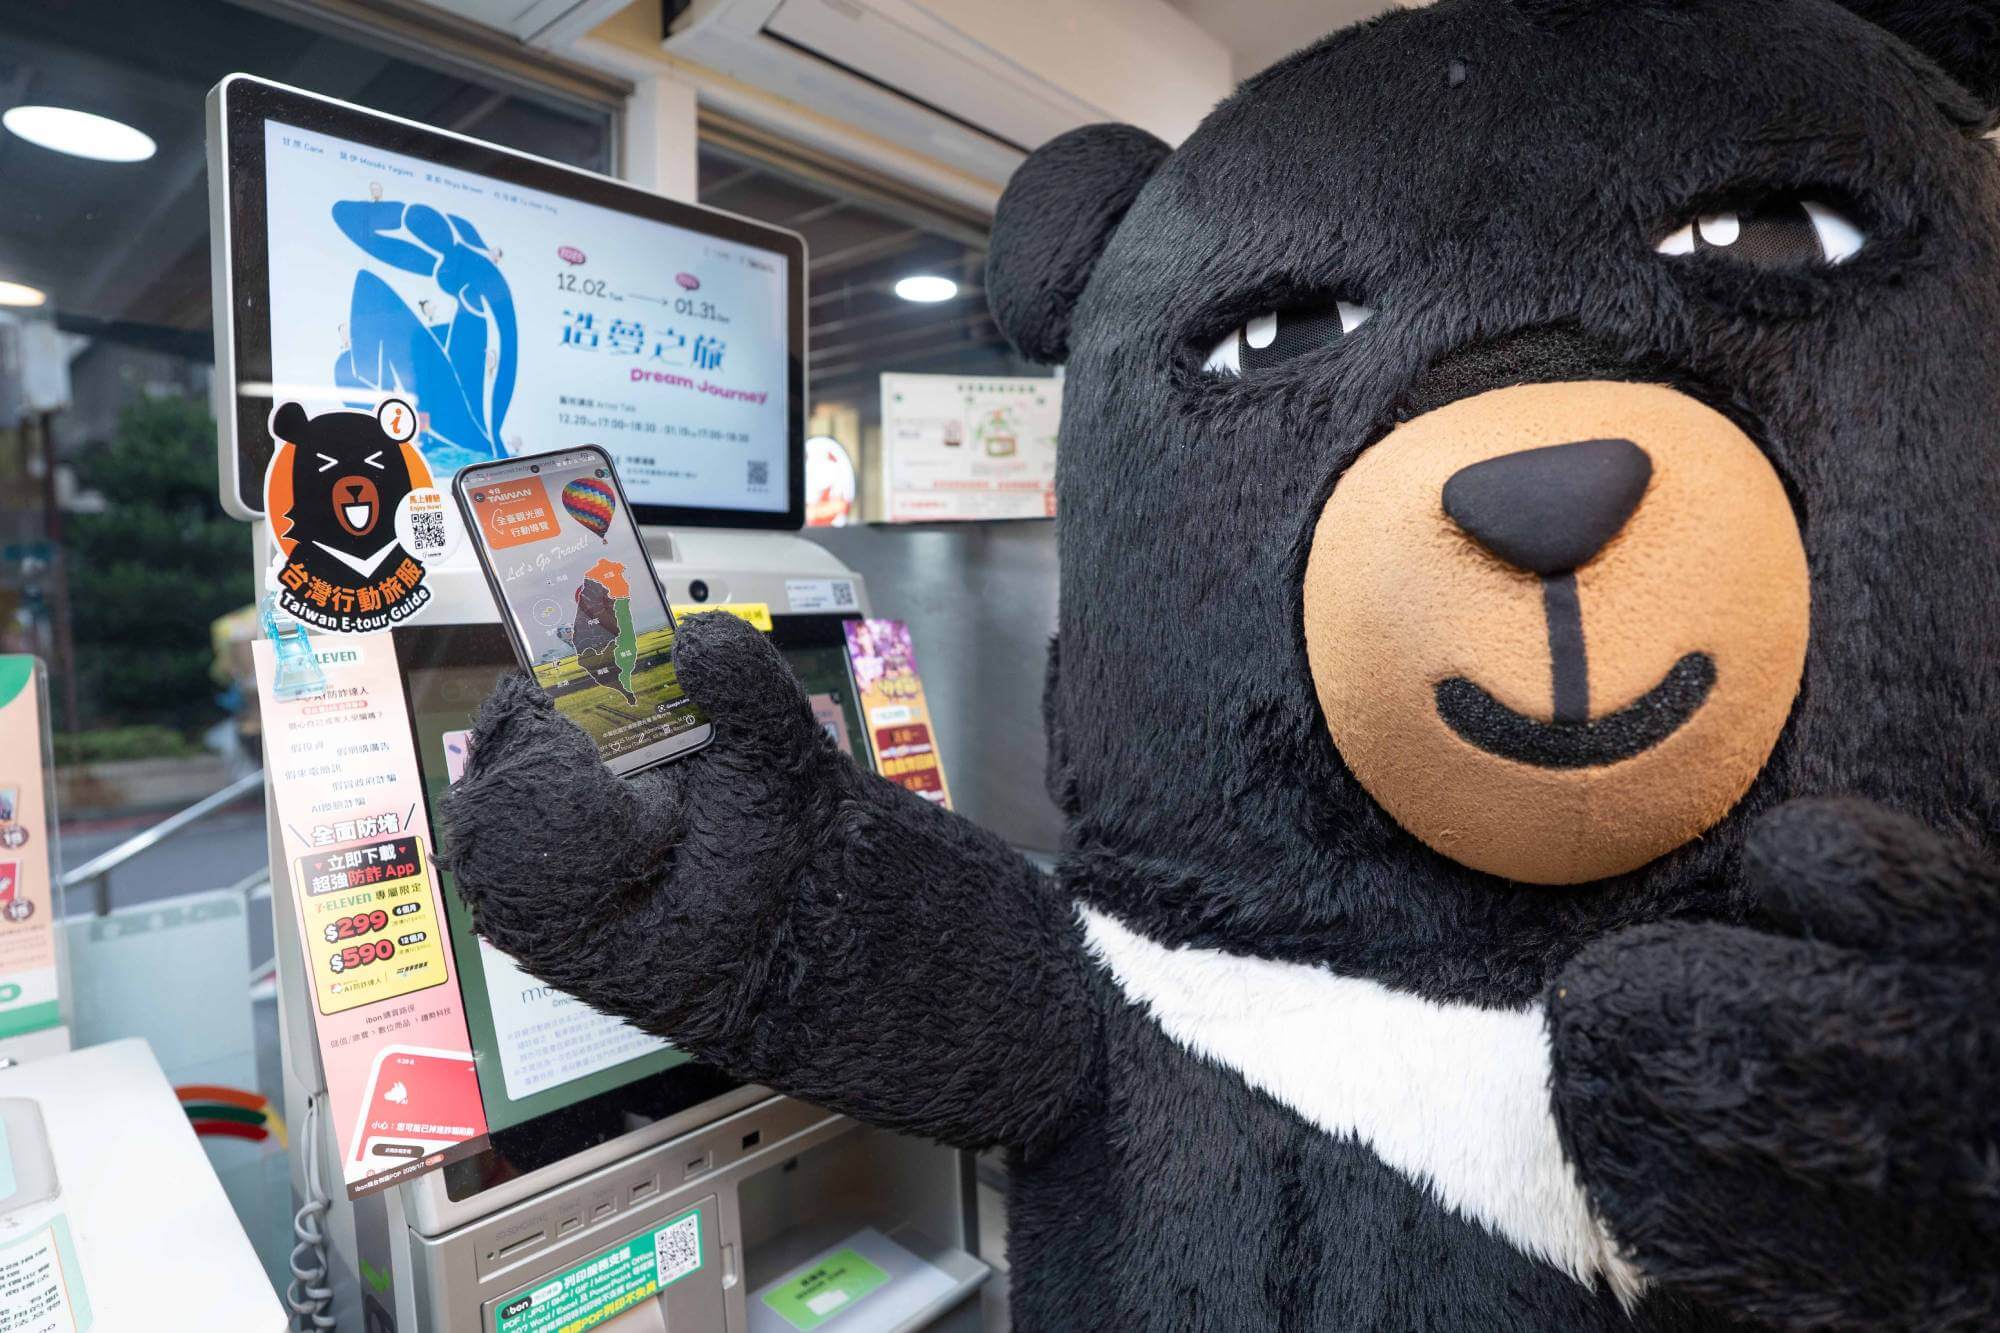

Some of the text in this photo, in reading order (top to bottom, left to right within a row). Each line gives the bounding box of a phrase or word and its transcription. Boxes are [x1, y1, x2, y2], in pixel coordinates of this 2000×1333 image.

[557, 272, 607, 299] 12.02
[675, 298, 716, 321] 01.31
[559, 307, 726, 373] 造夢之旅
[629, 367, 769, 405] Dream Journey
[487, 488, 532, 503] TAIWAN
[505, 561, 534, 582] Let's
[536, 553, 551, 571] Go
[281, 588, 429, 632] Taiwan E-tour Guide
[666, 701, 682, 709] Google
[311, 812, 400, 848] 全面防堵
[327, 843, 398, 872] 立即下載
[311, 861, 416, 894] 超強防詐 App
[323, 909, 389, 944] $299
[329, 938, 395, 975] $590
[365, 1012, 383, 1025] ibon
